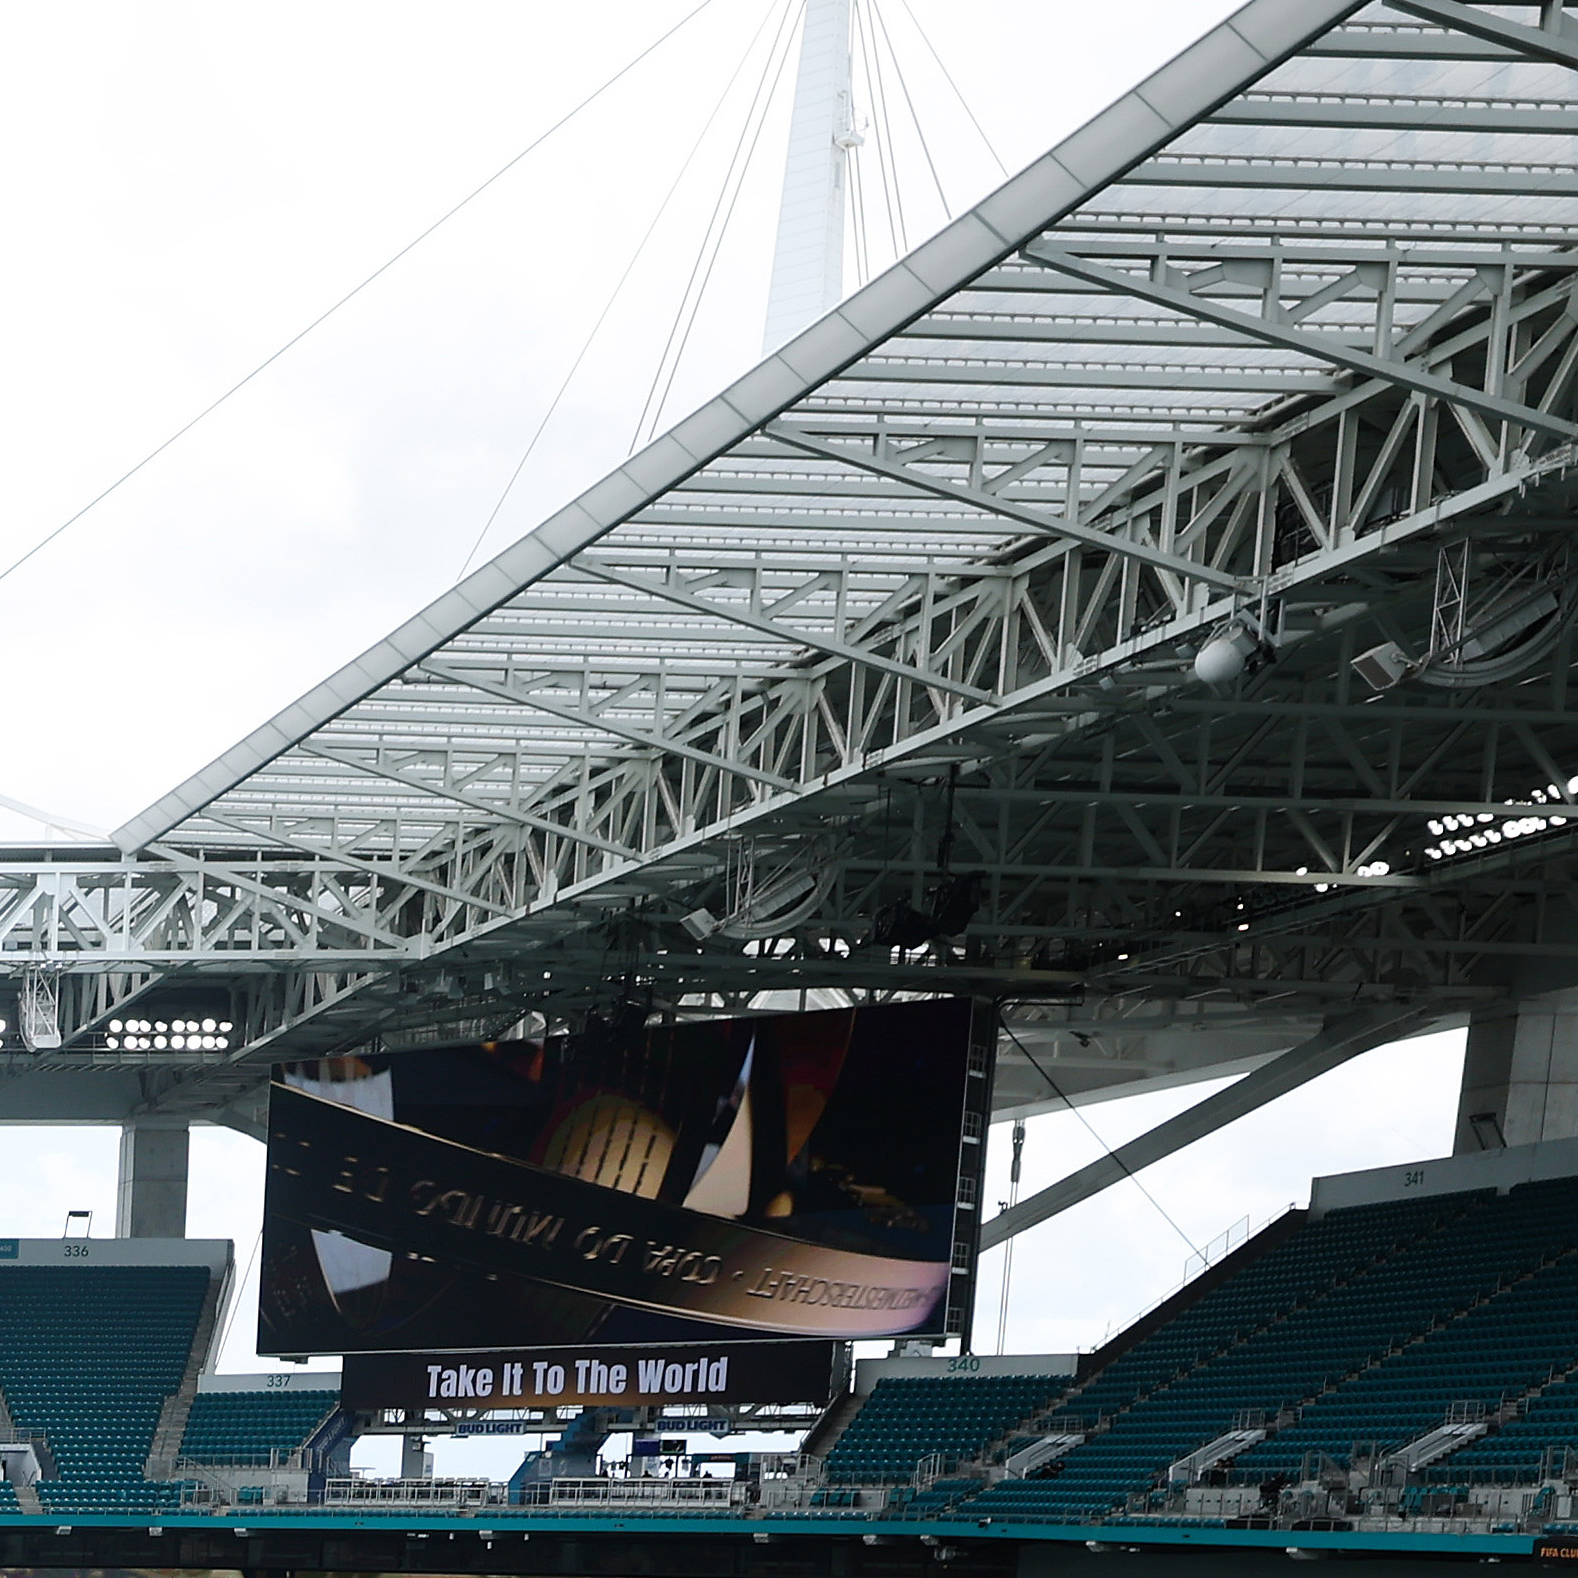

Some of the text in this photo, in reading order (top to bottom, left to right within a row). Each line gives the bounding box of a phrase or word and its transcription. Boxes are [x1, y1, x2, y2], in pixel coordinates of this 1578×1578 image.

[1404, 1171, 1424, 1187] 341
[64, 1244, 89, 1257] 336
[947, 1358, 980, 1372] 340
[266, 1375, 292, 1388] 337
[427, 1356, 728, 1399] Take It To The World
[458, 1423, 523, 1434] BUD LIGHT
[656, 1419, 727, 1432] BUD LIGHT
[1541, 1547, 1558, 1558] FIFA
